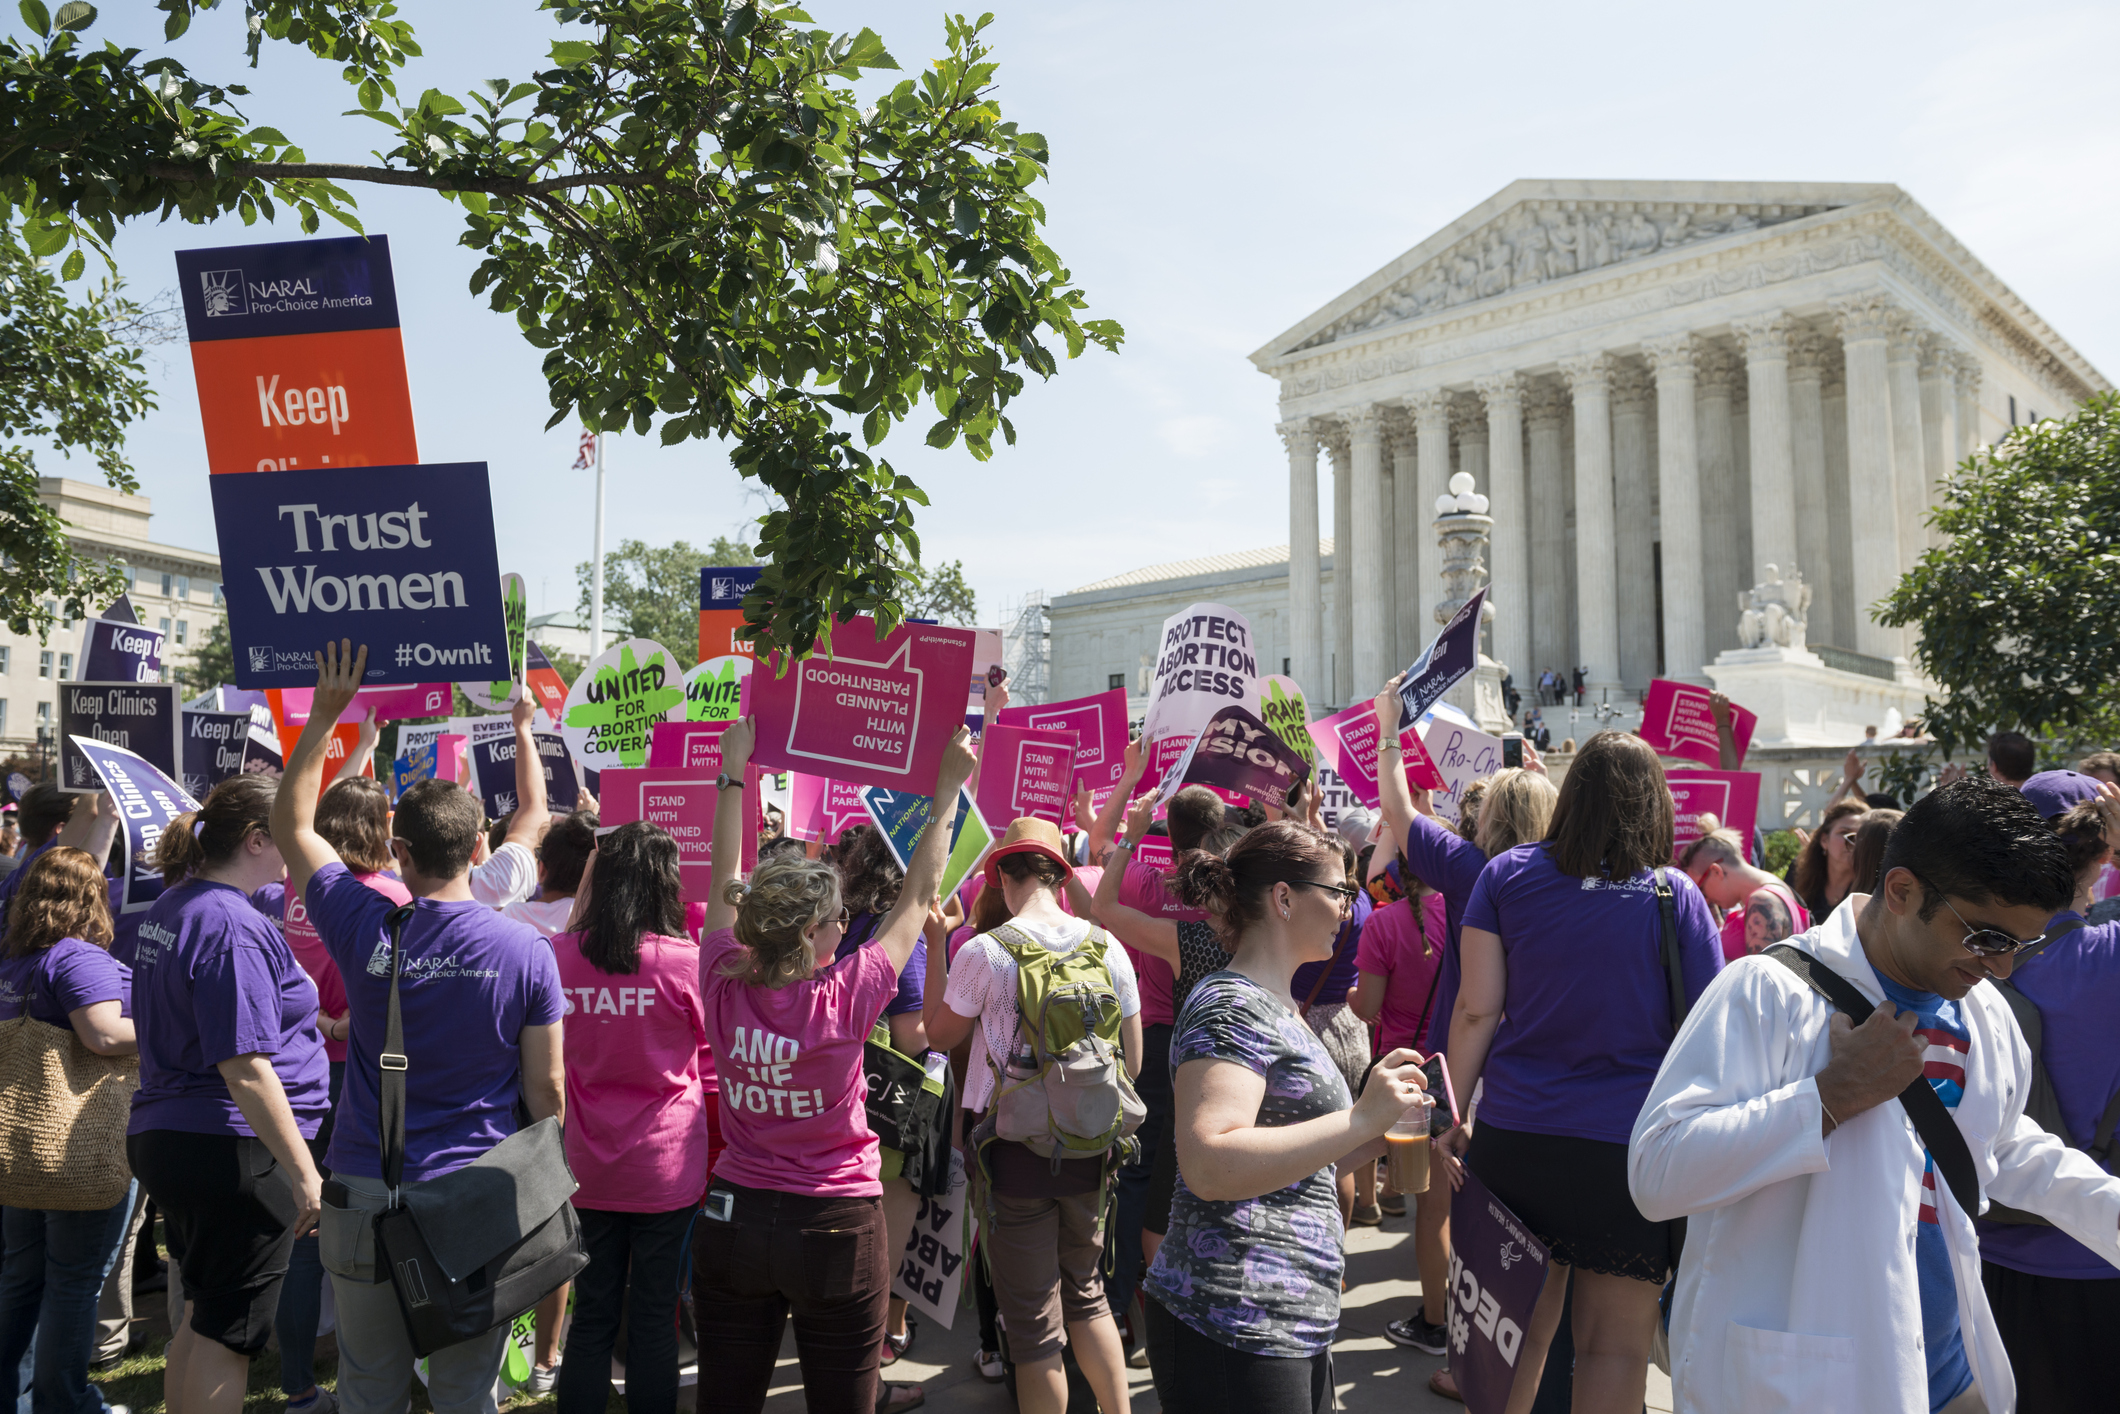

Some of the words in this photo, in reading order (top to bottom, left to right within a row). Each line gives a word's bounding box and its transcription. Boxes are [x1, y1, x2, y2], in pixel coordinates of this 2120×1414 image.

[249, 278, 317, 298] NARAL
[252, 299, 319, 314] Pro-Choice
[322, 294, 373, 309] America
[256, 374, 350, 436] Keep
[278, 501, 432, 553] Trust
[255, 564, 469, 614] Women
[1164, 615, 1247, 652] PROTECT
[111, 628, 151, 661] Keep
[395, 642, 493, 667] #OwnIt
[275, 651, 315, 662] NARAL
[1155, 642, 1257, 682] ABORTION
[586, 663, 666, 705] UNITED
[805, 668, 911, 697] PARENTHOOD
[1158, 669, 1245, 702] ACCESS
[1419, 670, 1447, 699] NARAL
[685, 681, 742, 705] UNITE
[71, 689, 104, 721] Keep
[108, 689, 158, 717] Clinics
[615, 700, 646, 718] FOR
[700, 706, 730, 719] FOR
[836, 692, 909, 716] PLANNED
[1676, 706, 1701, 718] WITH
[1677, 698, 1709, 711] STAND
[191, 715, 231, 745] Keep
[587, 710, 668, 739] ABORTION
[866, 716, 906, 736] WITH
[1345, 723, 1376, 742] STAND
[1674, 715, 1717, 732] PLANNED
[488, 741, 517, 763] Kee
[584, 734, 653, 755] COVERA
[692, 745, 722, 754] STAN
[852, 734, 904, 754] STAND
[1350, 736, 1375, 752] WITH
[216, 746, 242, 774] Open
[691, 757, 719, 767] WITH
[1025, 752, 1055, 765] STAND
[1357, 747, 1379, 763] PLAN
[1024, 765, 1048, 778] WITH
[101, 759, 153, 820] Clinics
[833, 784, 862, 794] PLAN
[1022, 779, 1060, 793] PLANNED
[150, 790, 182, 822] pen
[648, 795, 686, 807] STAND
[920, 802, 929, 817] OF
[648, 811, 678, 822] WITH
[889, 798, 922, 839] NATIONAL
[661, 826, 701, 838] ANNED
[907, 820, 928, 852] JEWIS
[1144, 855, 1172, 866] STAND
[1608, 883, 1649, 893] Pro-Choice
[1161, 903, 1181, 911] Act.
[404, 969, 457, 979] Pro-Choice
[458, 967, 499, 978] America
[406, 955, 460, 971] NARAL
[562, 987, 656, 1016] STAFF
[728, 1026, 800, 1065] AND
[724, 1076, 825, 1118] VOTE!
